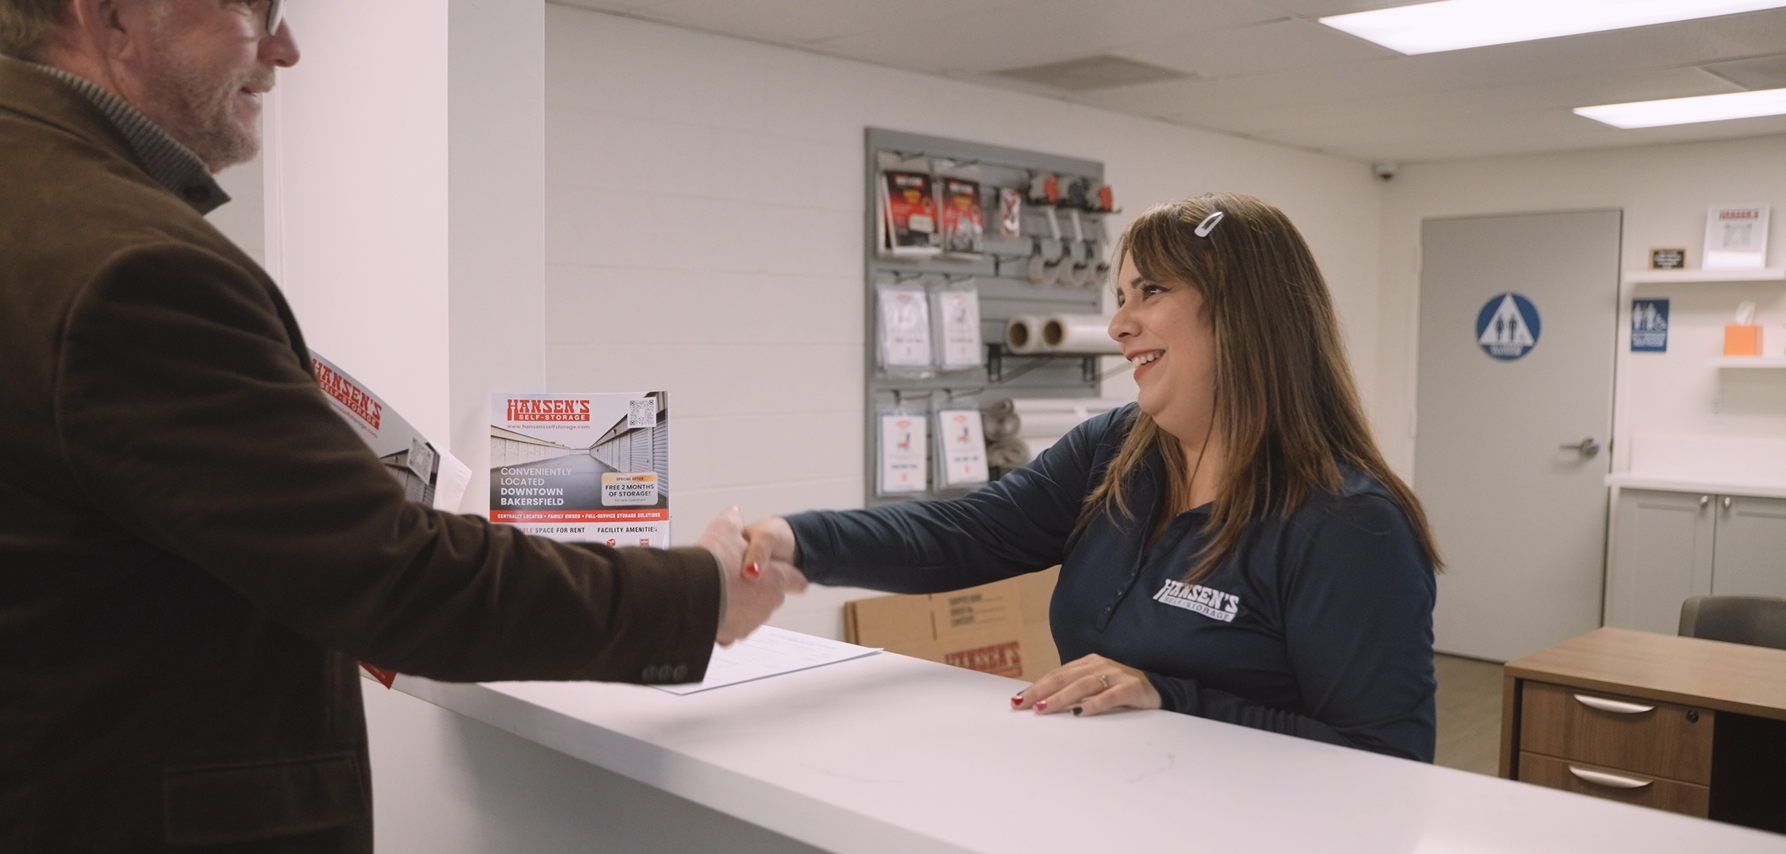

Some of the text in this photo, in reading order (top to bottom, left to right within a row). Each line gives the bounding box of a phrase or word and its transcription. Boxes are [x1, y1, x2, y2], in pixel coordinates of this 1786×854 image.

[312, 358, 382, 420] HANSEN'S
[320, 380, 377, 426] SELF-STORAGE
[507, 399, 590, 420] HANSEN'S
[500, 467, 573, 476] CONVENIENTLY
[500, 477, 545, 486] LOCATED
[500, 487, 564, 496] DOWNTOWN
[500, 497, 564, 506] BAKERSFIELD
[1152, 578, 1240, 614] HANSEN'S
[1163, 596, 1231, 620] SELF-STORAGE
